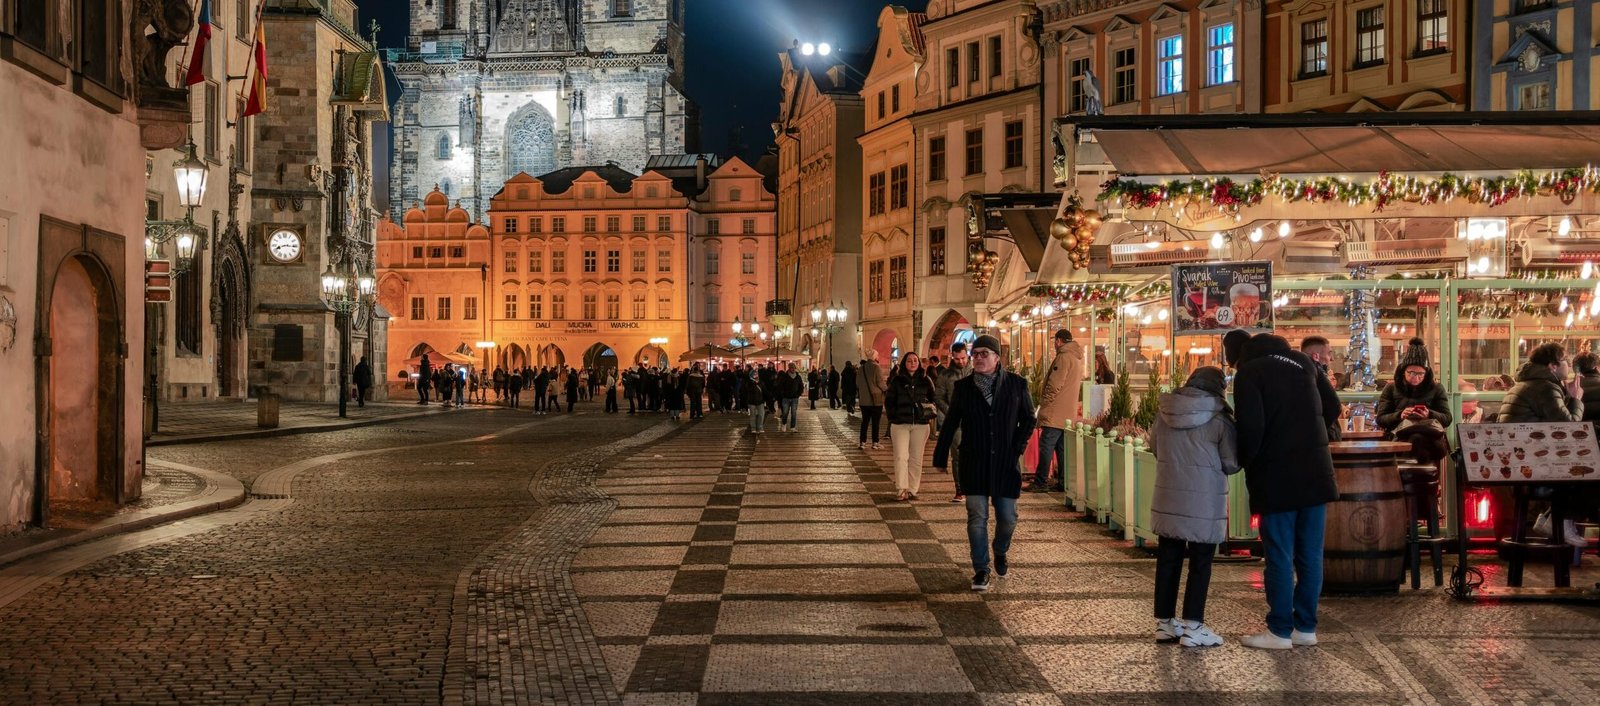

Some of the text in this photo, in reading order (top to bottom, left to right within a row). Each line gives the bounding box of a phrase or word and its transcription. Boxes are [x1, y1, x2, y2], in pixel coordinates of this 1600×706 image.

[1232, 270, 1250, 284] Pivo
[567, 321, 593, 329] MUCHA
[610, 321, 640, 329] WARHOL
